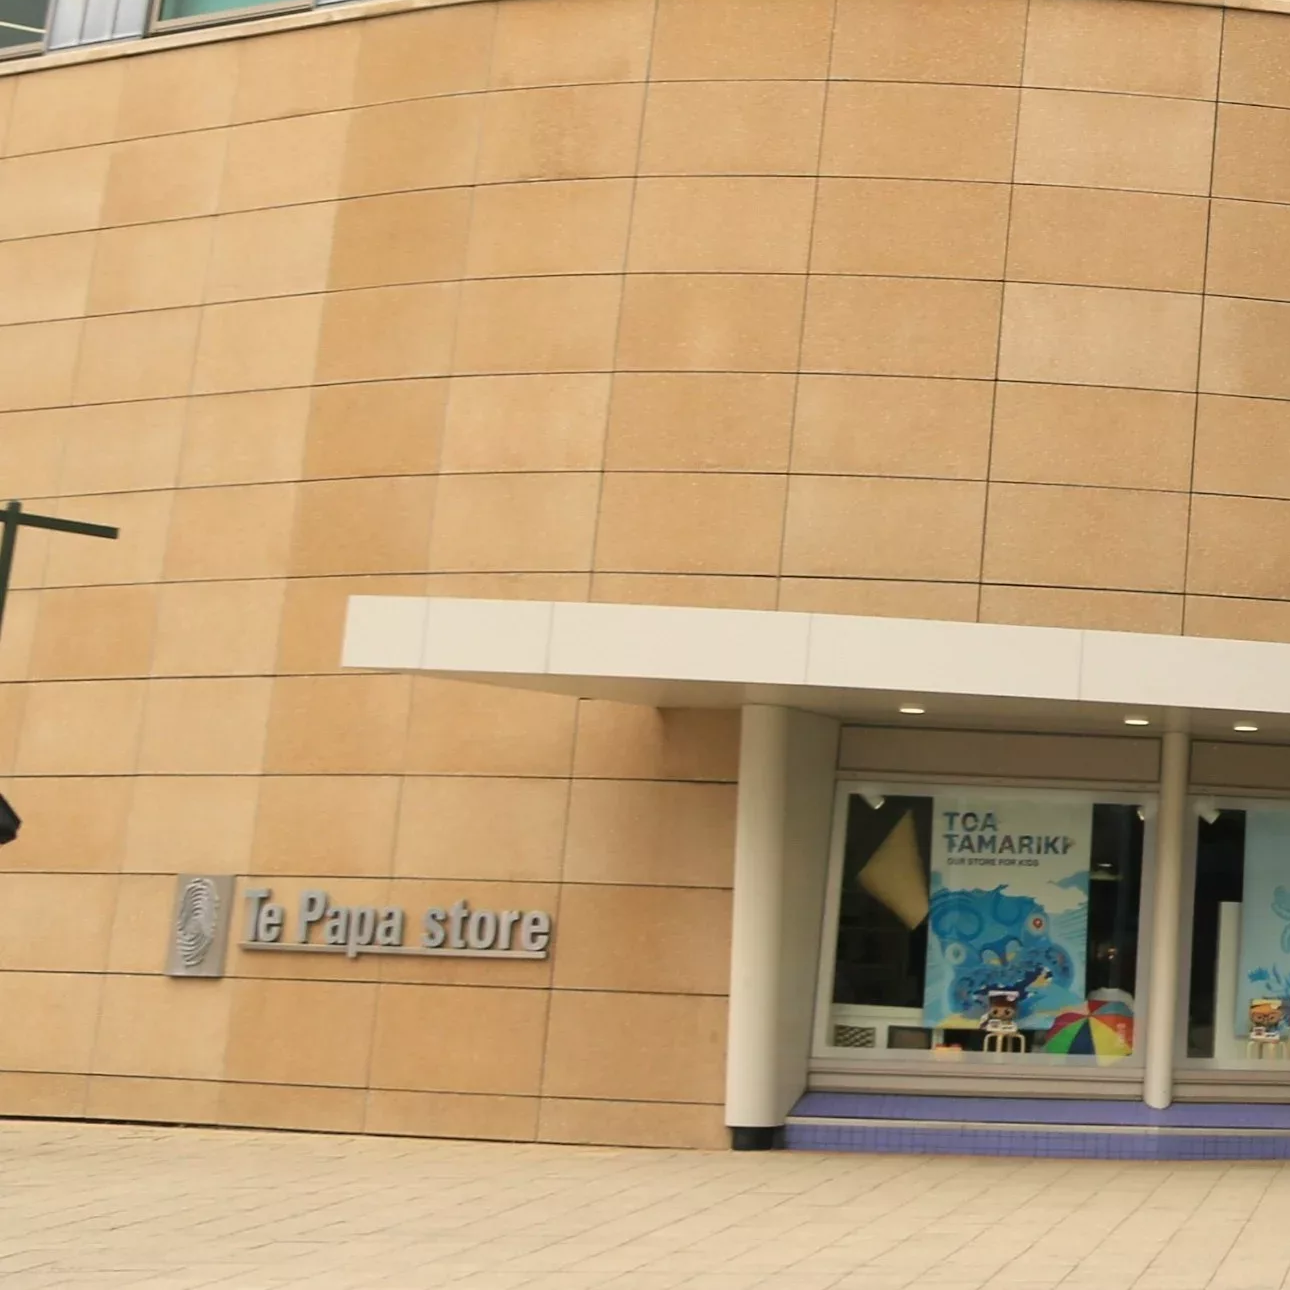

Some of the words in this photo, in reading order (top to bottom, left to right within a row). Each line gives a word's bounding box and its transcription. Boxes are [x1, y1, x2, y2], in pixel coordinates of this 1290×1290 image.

[968, 857, 996, 867] STORE
[245, 887, 284, 944] Te
[299, 888, 404, 958] Papa
[421, 898, 551, 952] store
